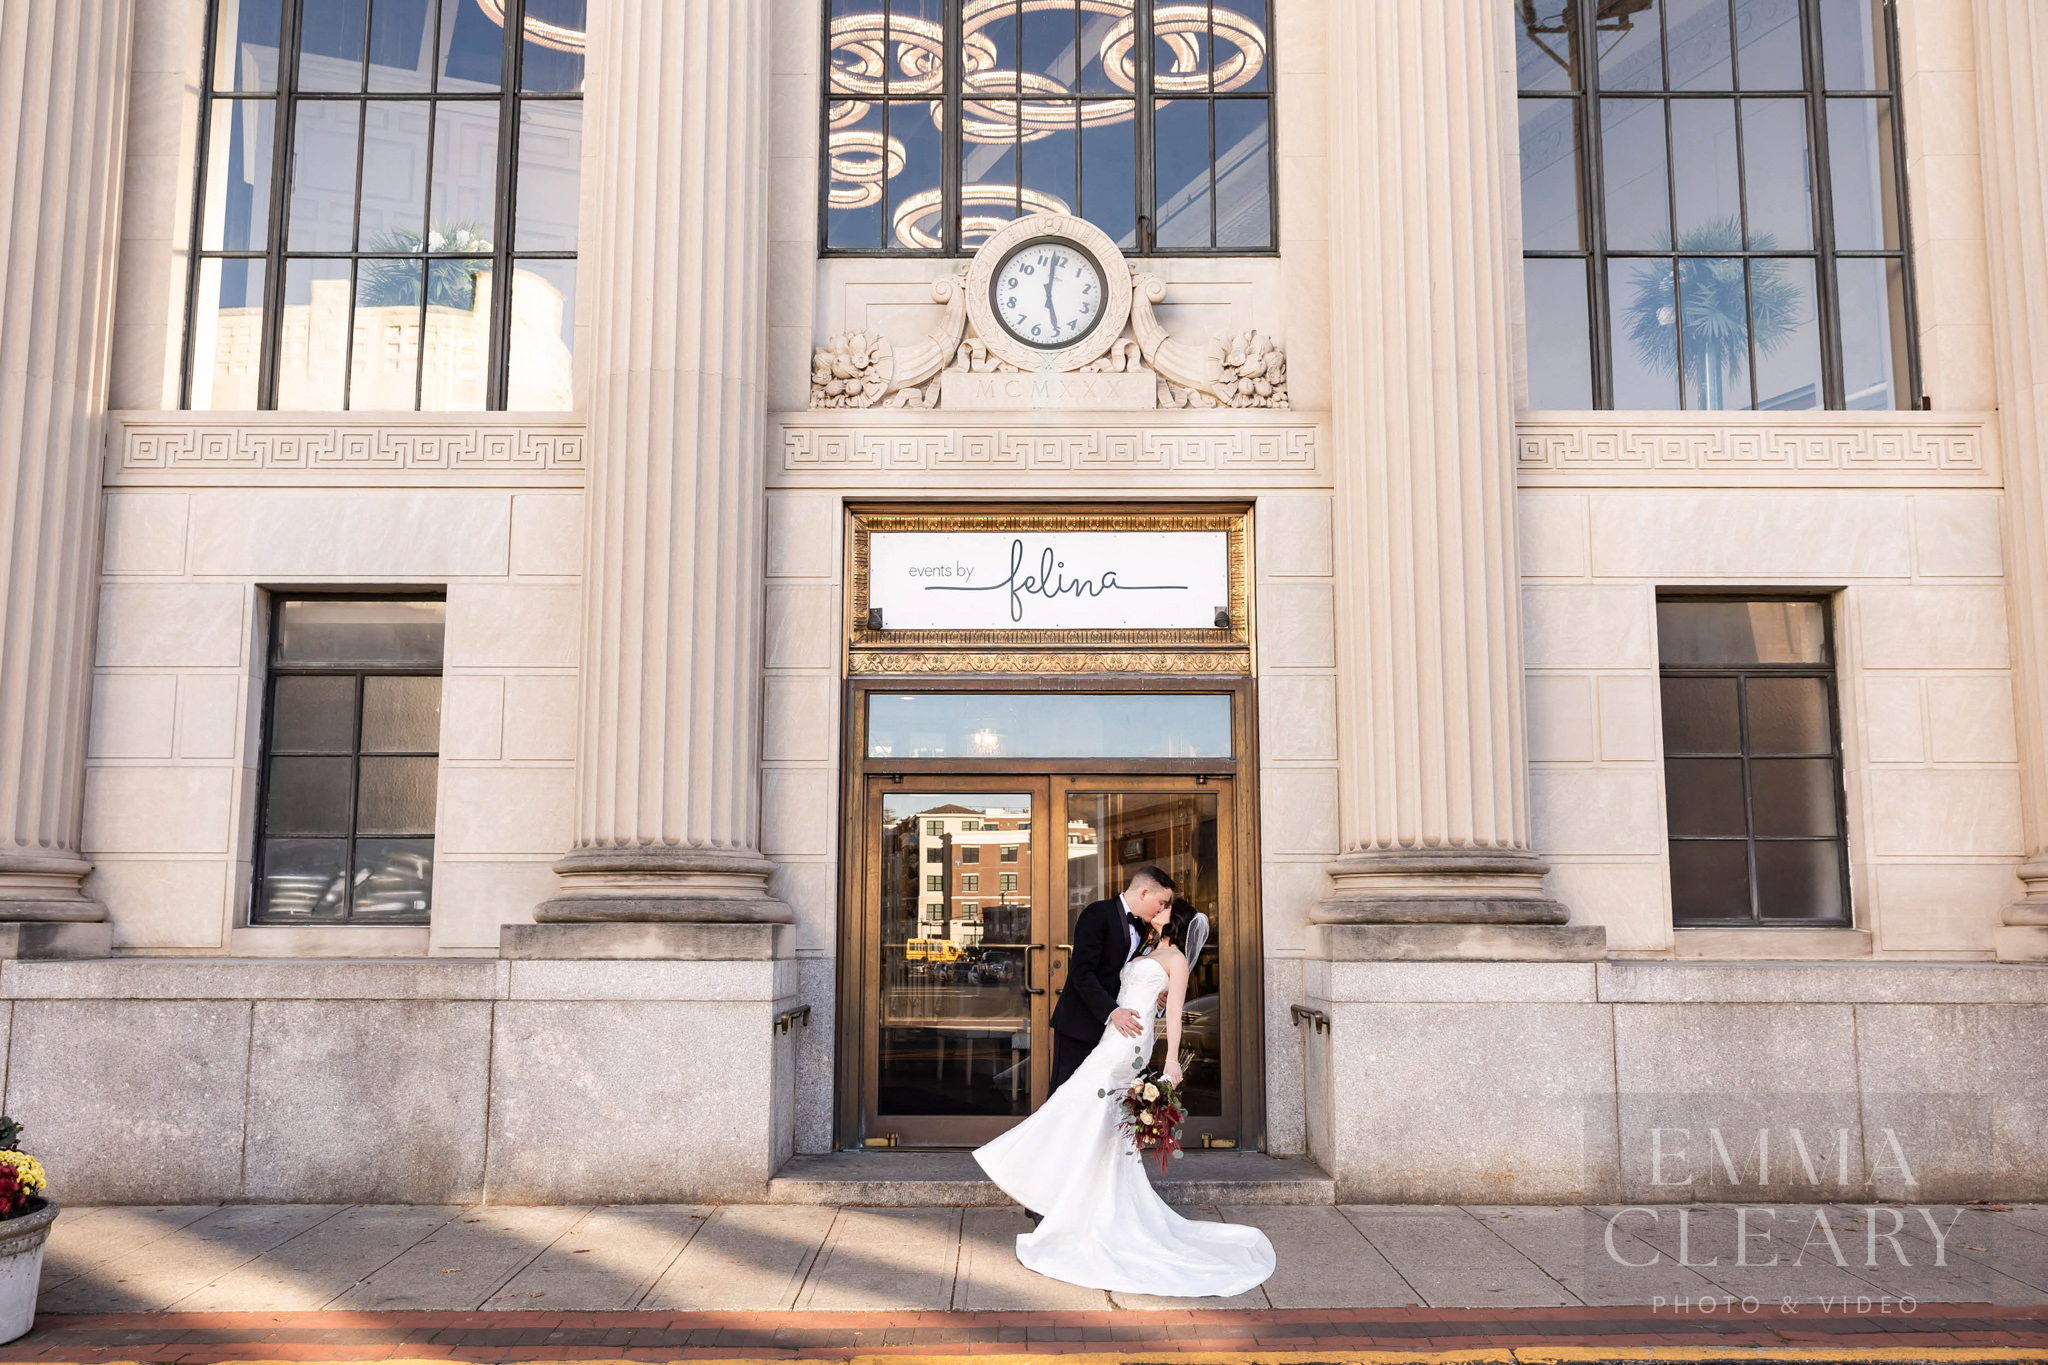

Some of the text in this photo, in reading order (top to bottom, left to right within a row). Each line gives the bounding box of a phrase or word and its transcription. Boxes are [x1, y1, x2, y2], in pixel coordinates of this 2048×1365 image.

[1037, 255, 1048, 266] 11
[1055, 255, 1069, 268] 12
[1019, 263, 1035, 275] 10
[1075, 268, 1083, 278] 1
[1008, 278, 1018, 290] 9
[1082, 284, 1091, 294] 2
[1007, 297, 1017, 308] 8
[1079, 302, 1090, 314] 3
[1017, 314, 1028, 325] 7
[1066, 319, 1078, 330] 4
[1031, 324, 1041, 336] 6
[1050, 326, 1061, 338] 5
[976, 380, 1121, 398] MCMXXX
[908, 539, 1188, 622] events by felina
